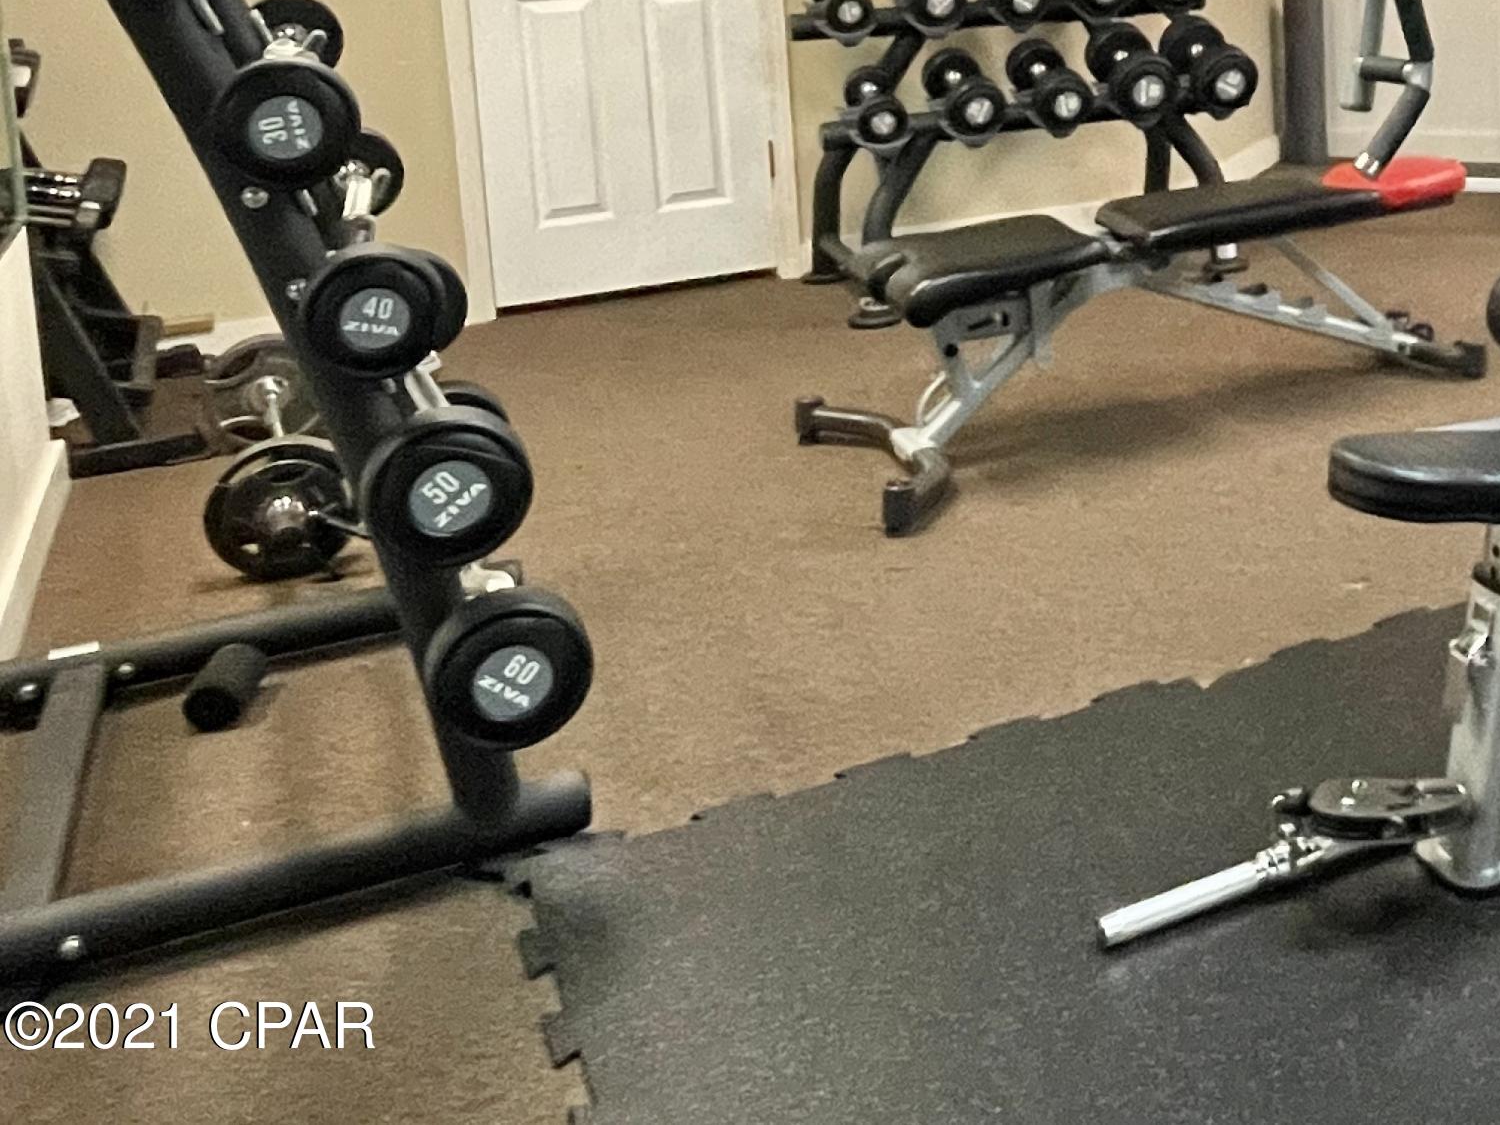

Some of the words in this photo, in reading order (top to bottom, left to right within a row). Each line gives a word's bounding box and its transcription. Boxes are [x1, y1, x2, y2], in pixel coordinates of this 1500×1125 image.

[258, 116, 288, 145] 30
[363, 296, 394, 320] 40
[342, 321, 399, 336] ZIVA
[421, 471, 460, 505] 50
[433, 483, 488, 529] ZIVA
[503, 655, 540, 685] 60
[478, 674, 530, 707] ZIVA
